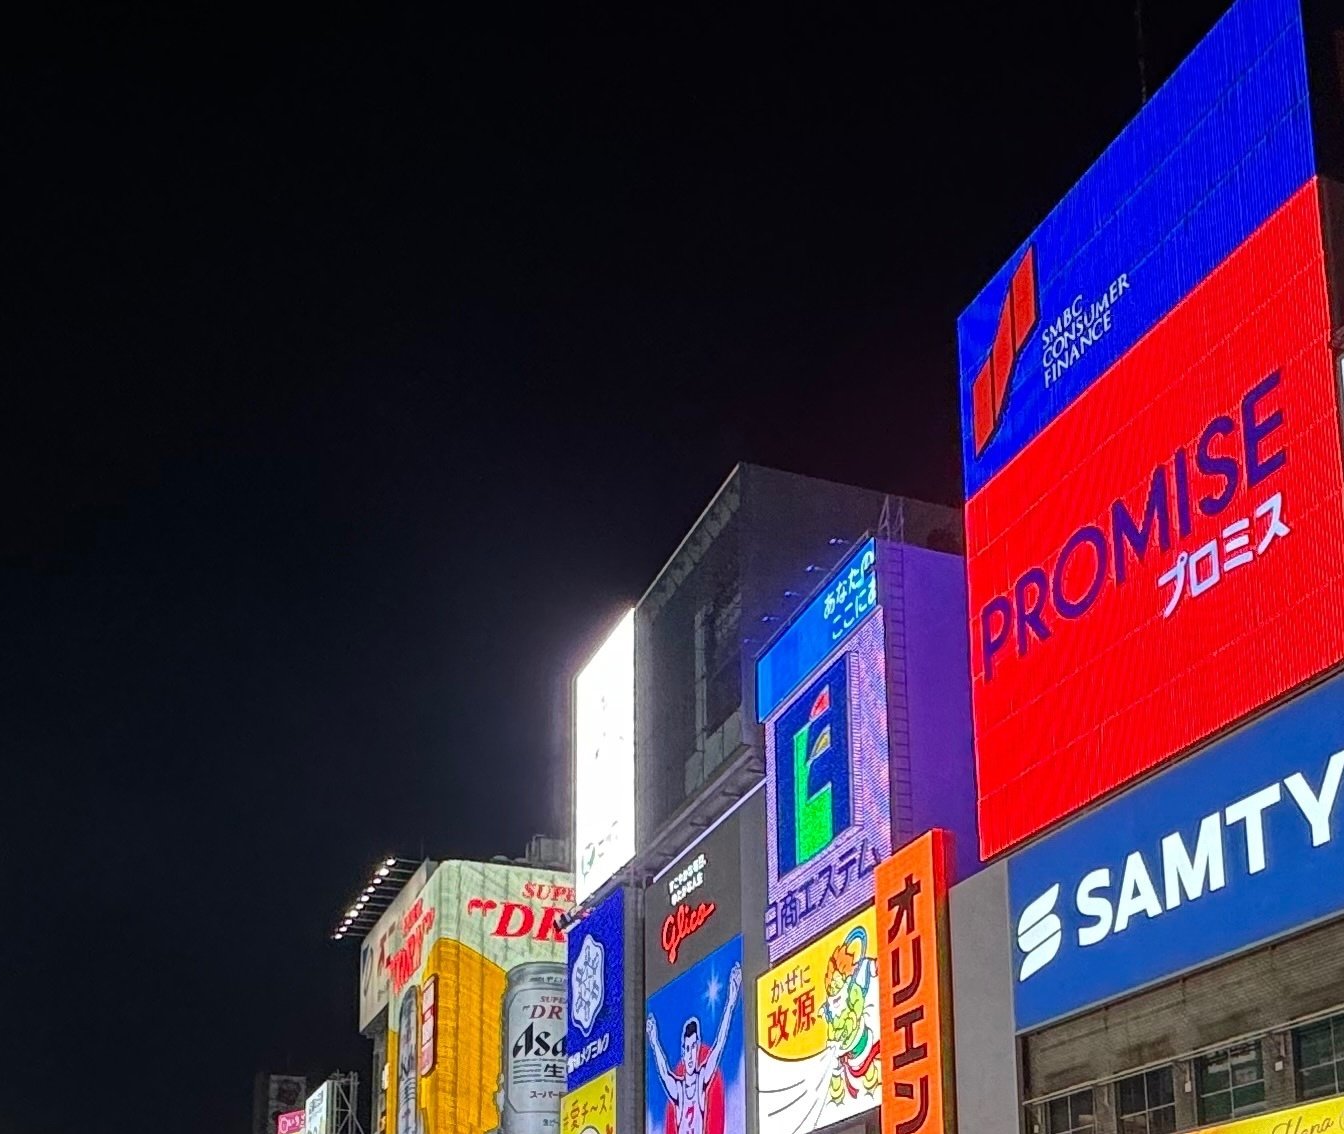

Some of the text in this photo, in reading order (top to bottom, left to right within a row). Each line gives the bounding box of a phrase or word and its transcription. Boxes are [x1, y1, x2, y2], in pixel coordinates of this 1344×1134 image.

[1040, 292, 1084, 350] SMBC
[1042, 274, 1130, 369] CONSUMER
[1043, 310, 1111, 389] FINANCE
[981, 370, 1288, 683] PROMISE
[1158, 490, 1291, 618] プロミス
[765, 838, 882, 943] 日商エステム
[661, 903, 716, 964] Glico
[769, 962, 813, 1006] かぜに
[512, 1023, 568, 1057] Asa
[766, 990, 817, 1051] 改源
